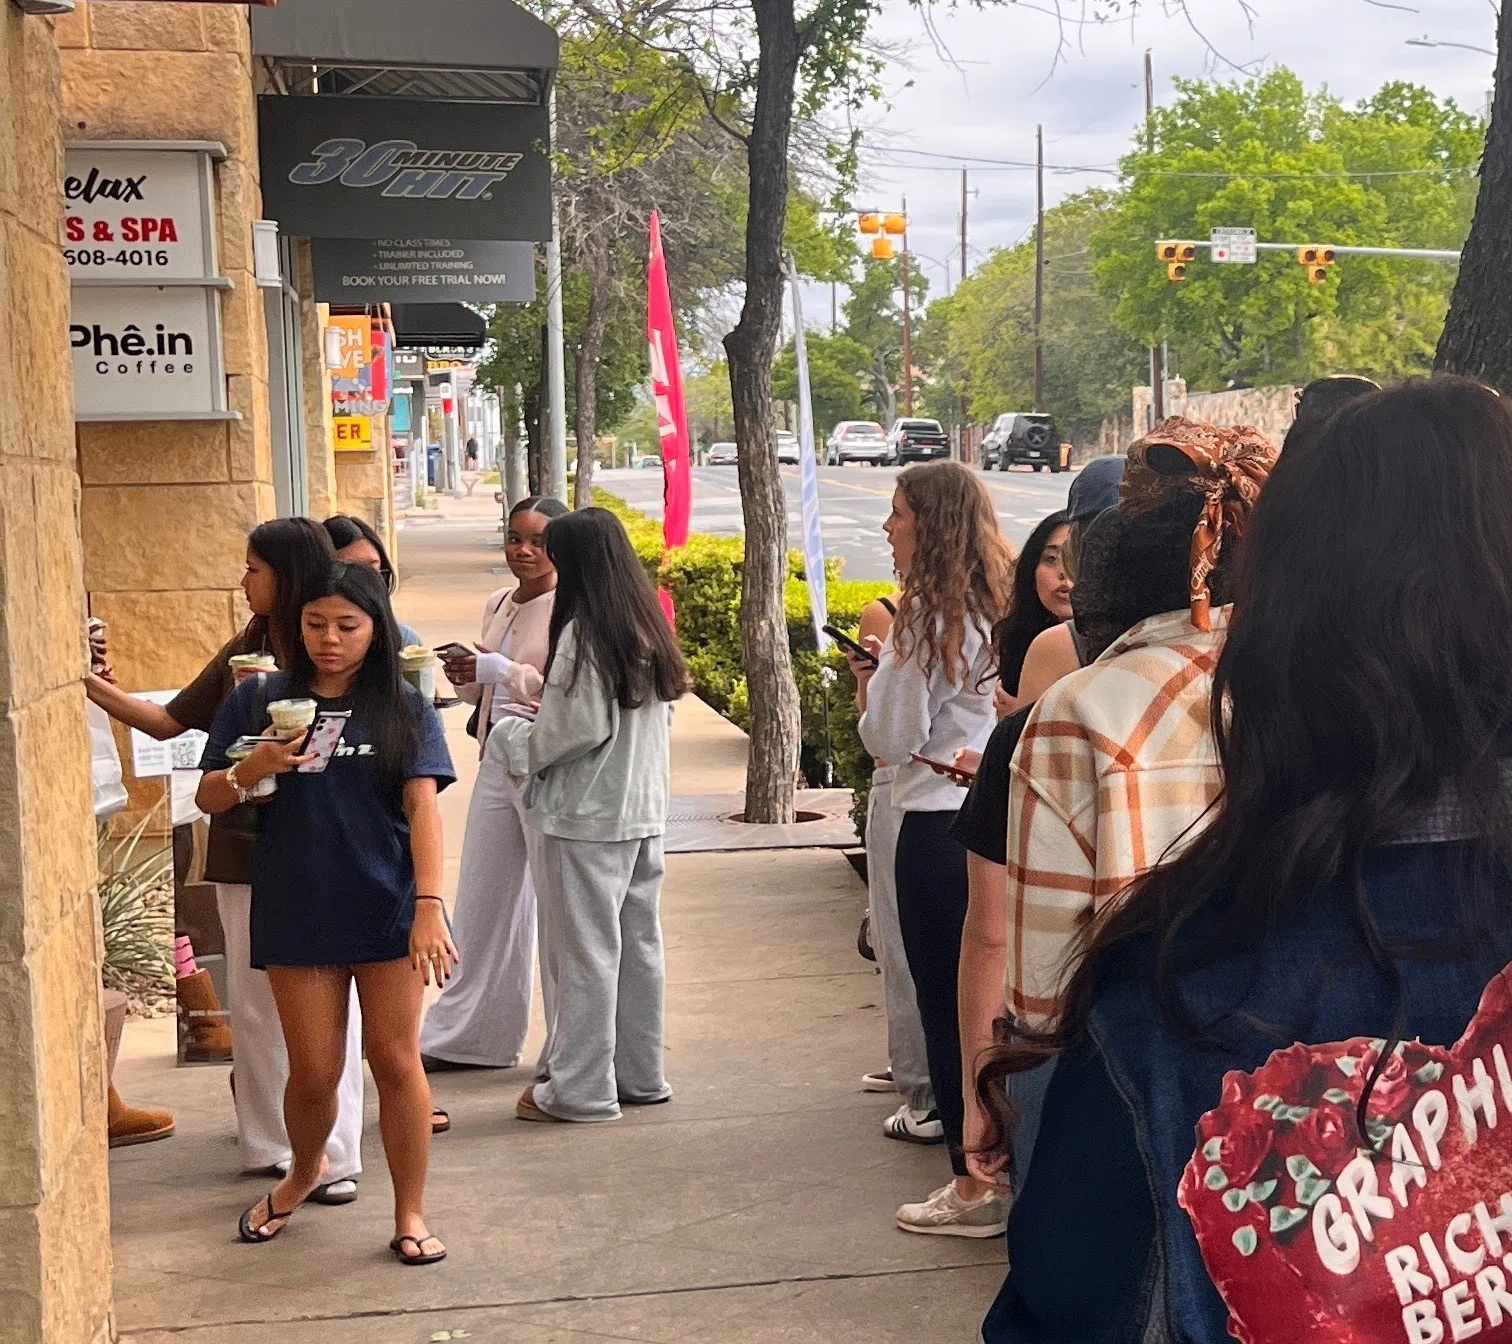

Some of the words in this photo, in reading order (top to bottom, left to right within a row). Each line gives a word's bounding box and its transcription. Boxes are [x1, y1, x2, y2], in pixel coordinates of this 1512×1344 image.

[288, 138, 417, 187] 30
[389, 149, 524, 171] MINUTE
[64, 167, 147, 204] elax
[381, 169, 507, 200] HIT
[93, 220, 114, 242] &
[121, 217, 179, 242] SPA
[431, 261, 474, 270] TRAINING
[342, 275, 377, 286] BOOK
[377, 275, 410, 286] YOUR
[411, 275, 438, 285] FREE
[440, 275, 472, 285] TRIAL
[473, 274, 506, 285] NOW!
[96, 360, 194, 374] Coffee
